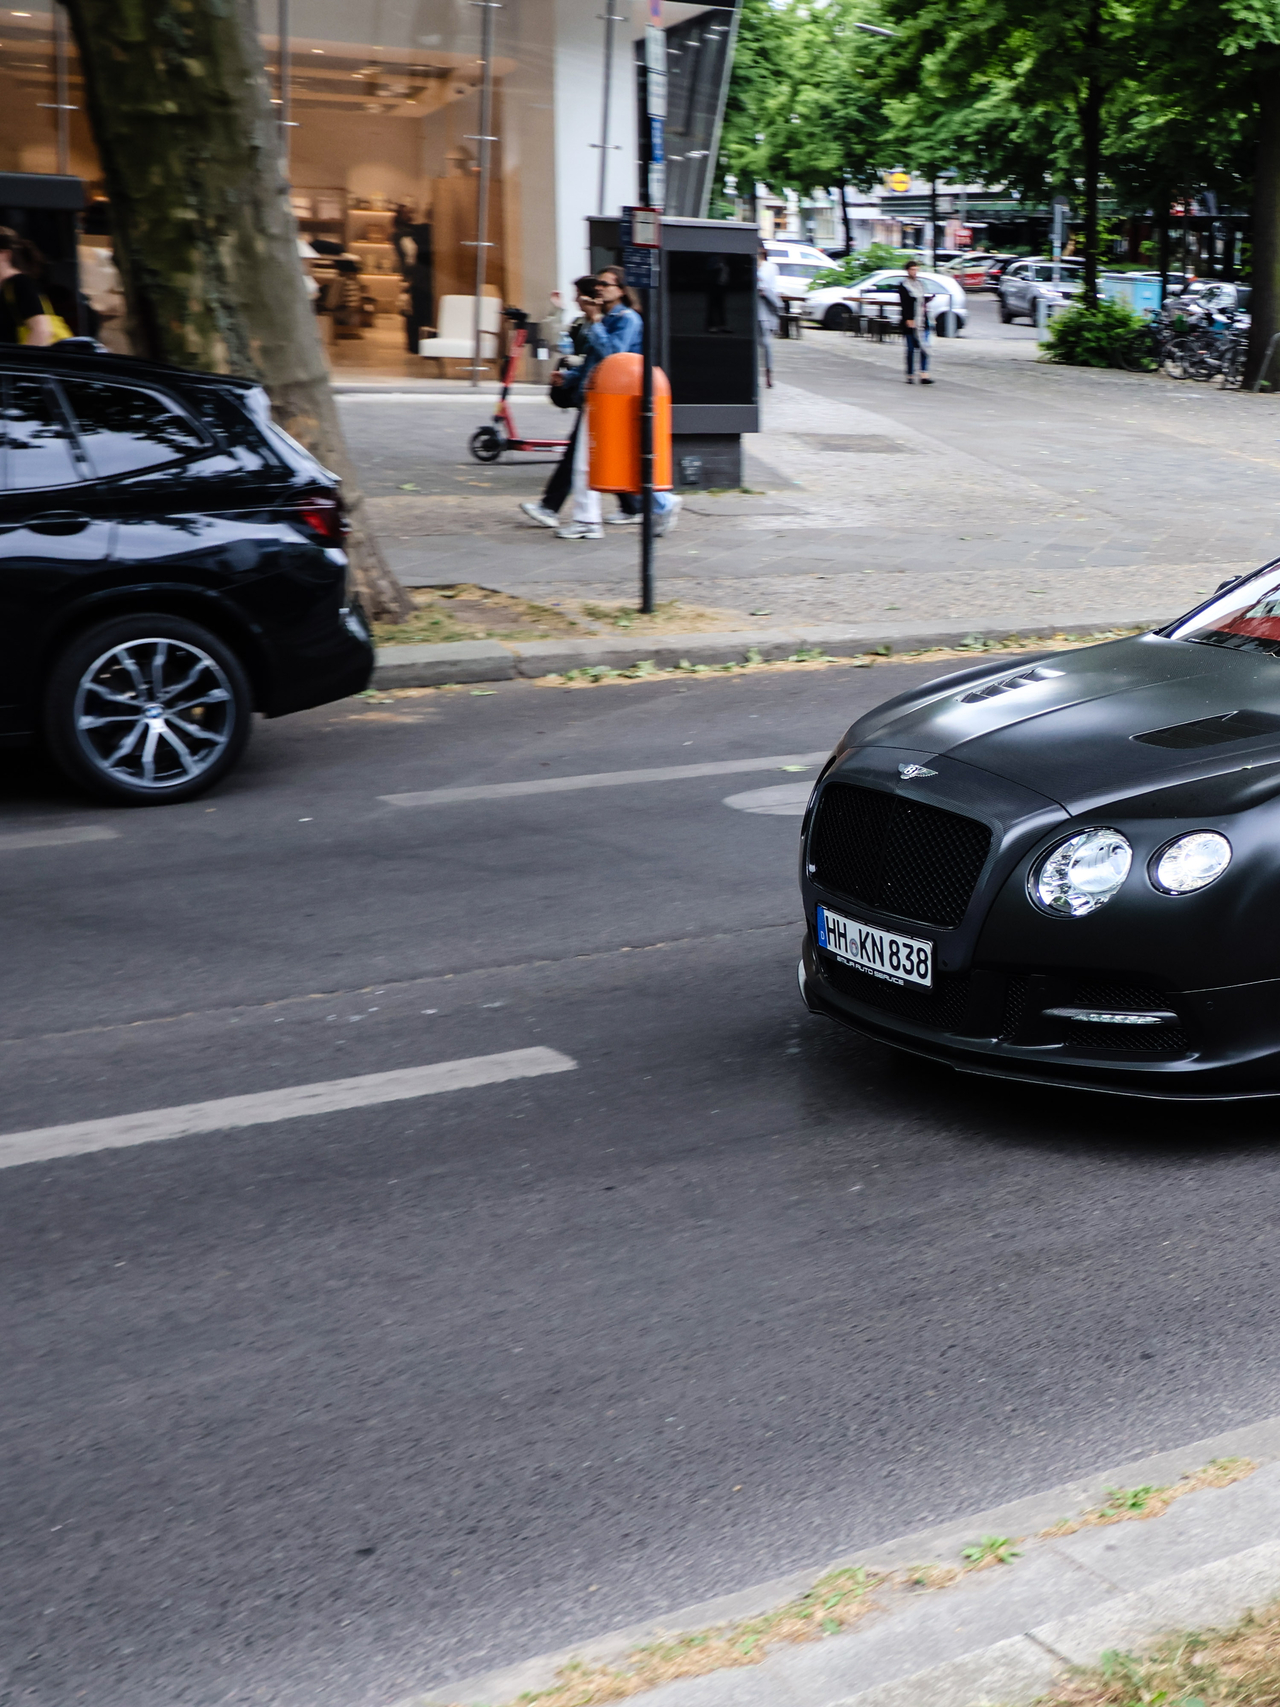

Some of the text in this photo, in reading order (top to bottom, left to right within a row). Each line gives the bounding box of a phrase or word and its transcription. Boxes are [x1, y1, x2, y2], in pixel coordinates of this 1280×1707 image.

[825, 915, 930, 980] HH KN 838
[855, 963, 874, 976] AUTO
[873, 970, 905, 986] SERVICE
